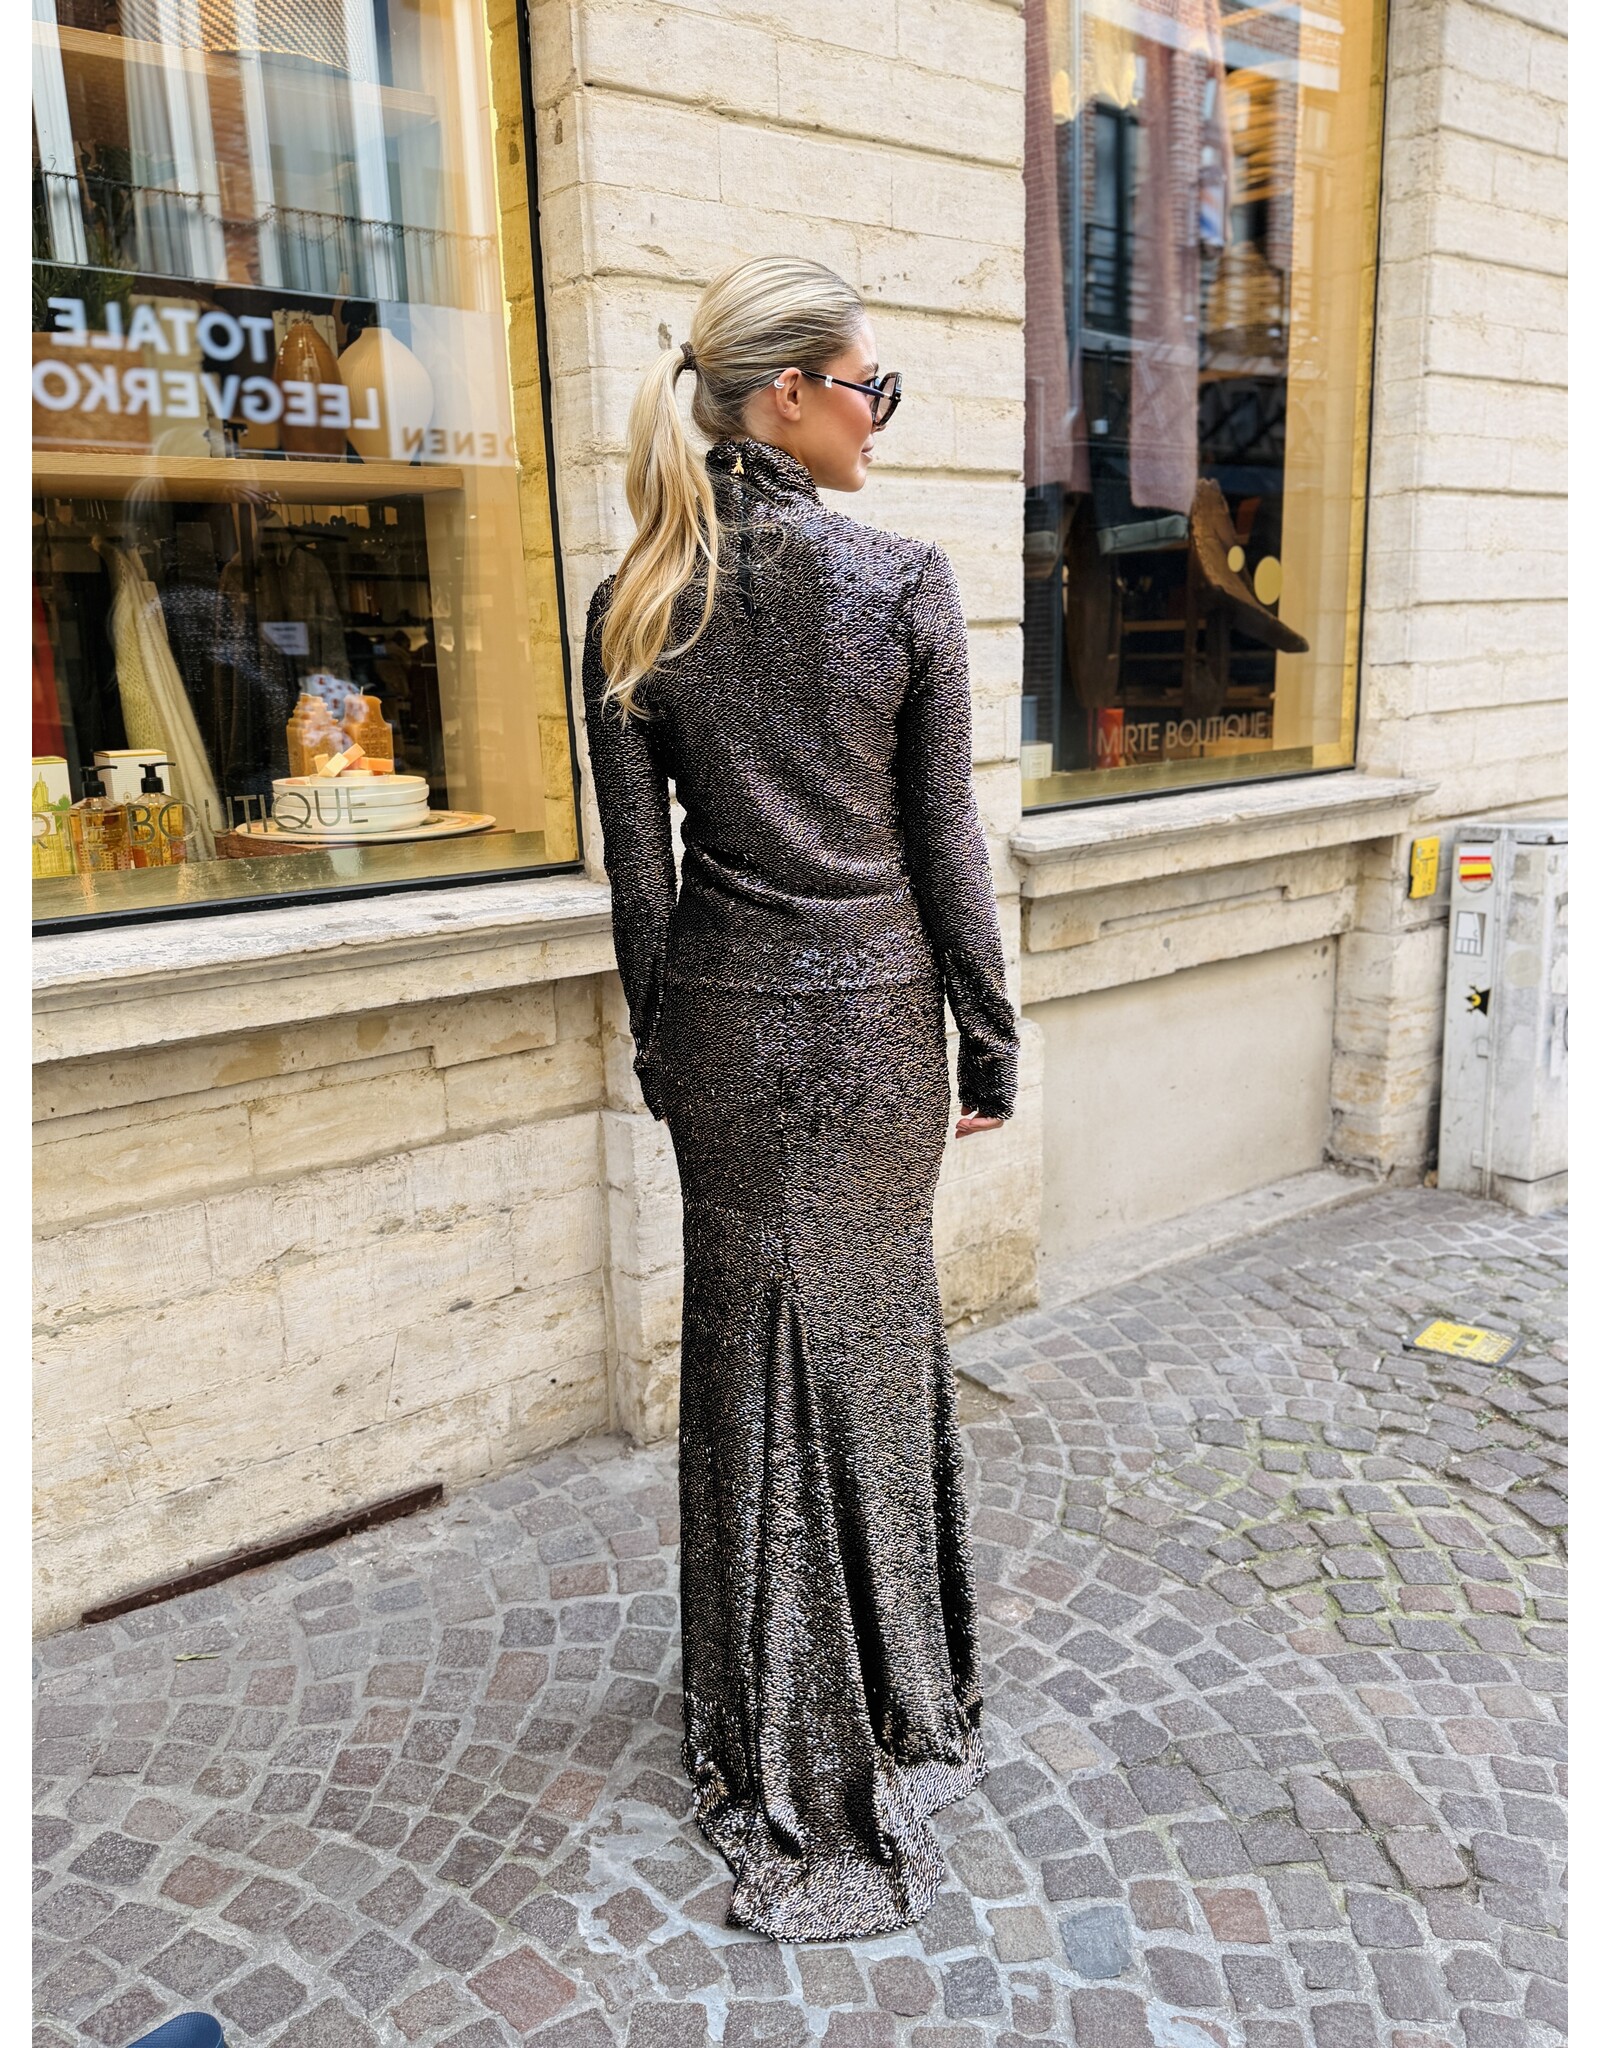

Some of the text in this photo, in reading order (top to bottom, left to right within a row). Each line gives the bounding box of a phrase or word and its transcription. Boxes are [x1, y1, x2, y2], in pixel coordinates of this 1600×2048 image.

[1098, 711, 1267, 756] MIRTE BOUTIQUE
[126, 787, 369, 846] BOUTIQUE
